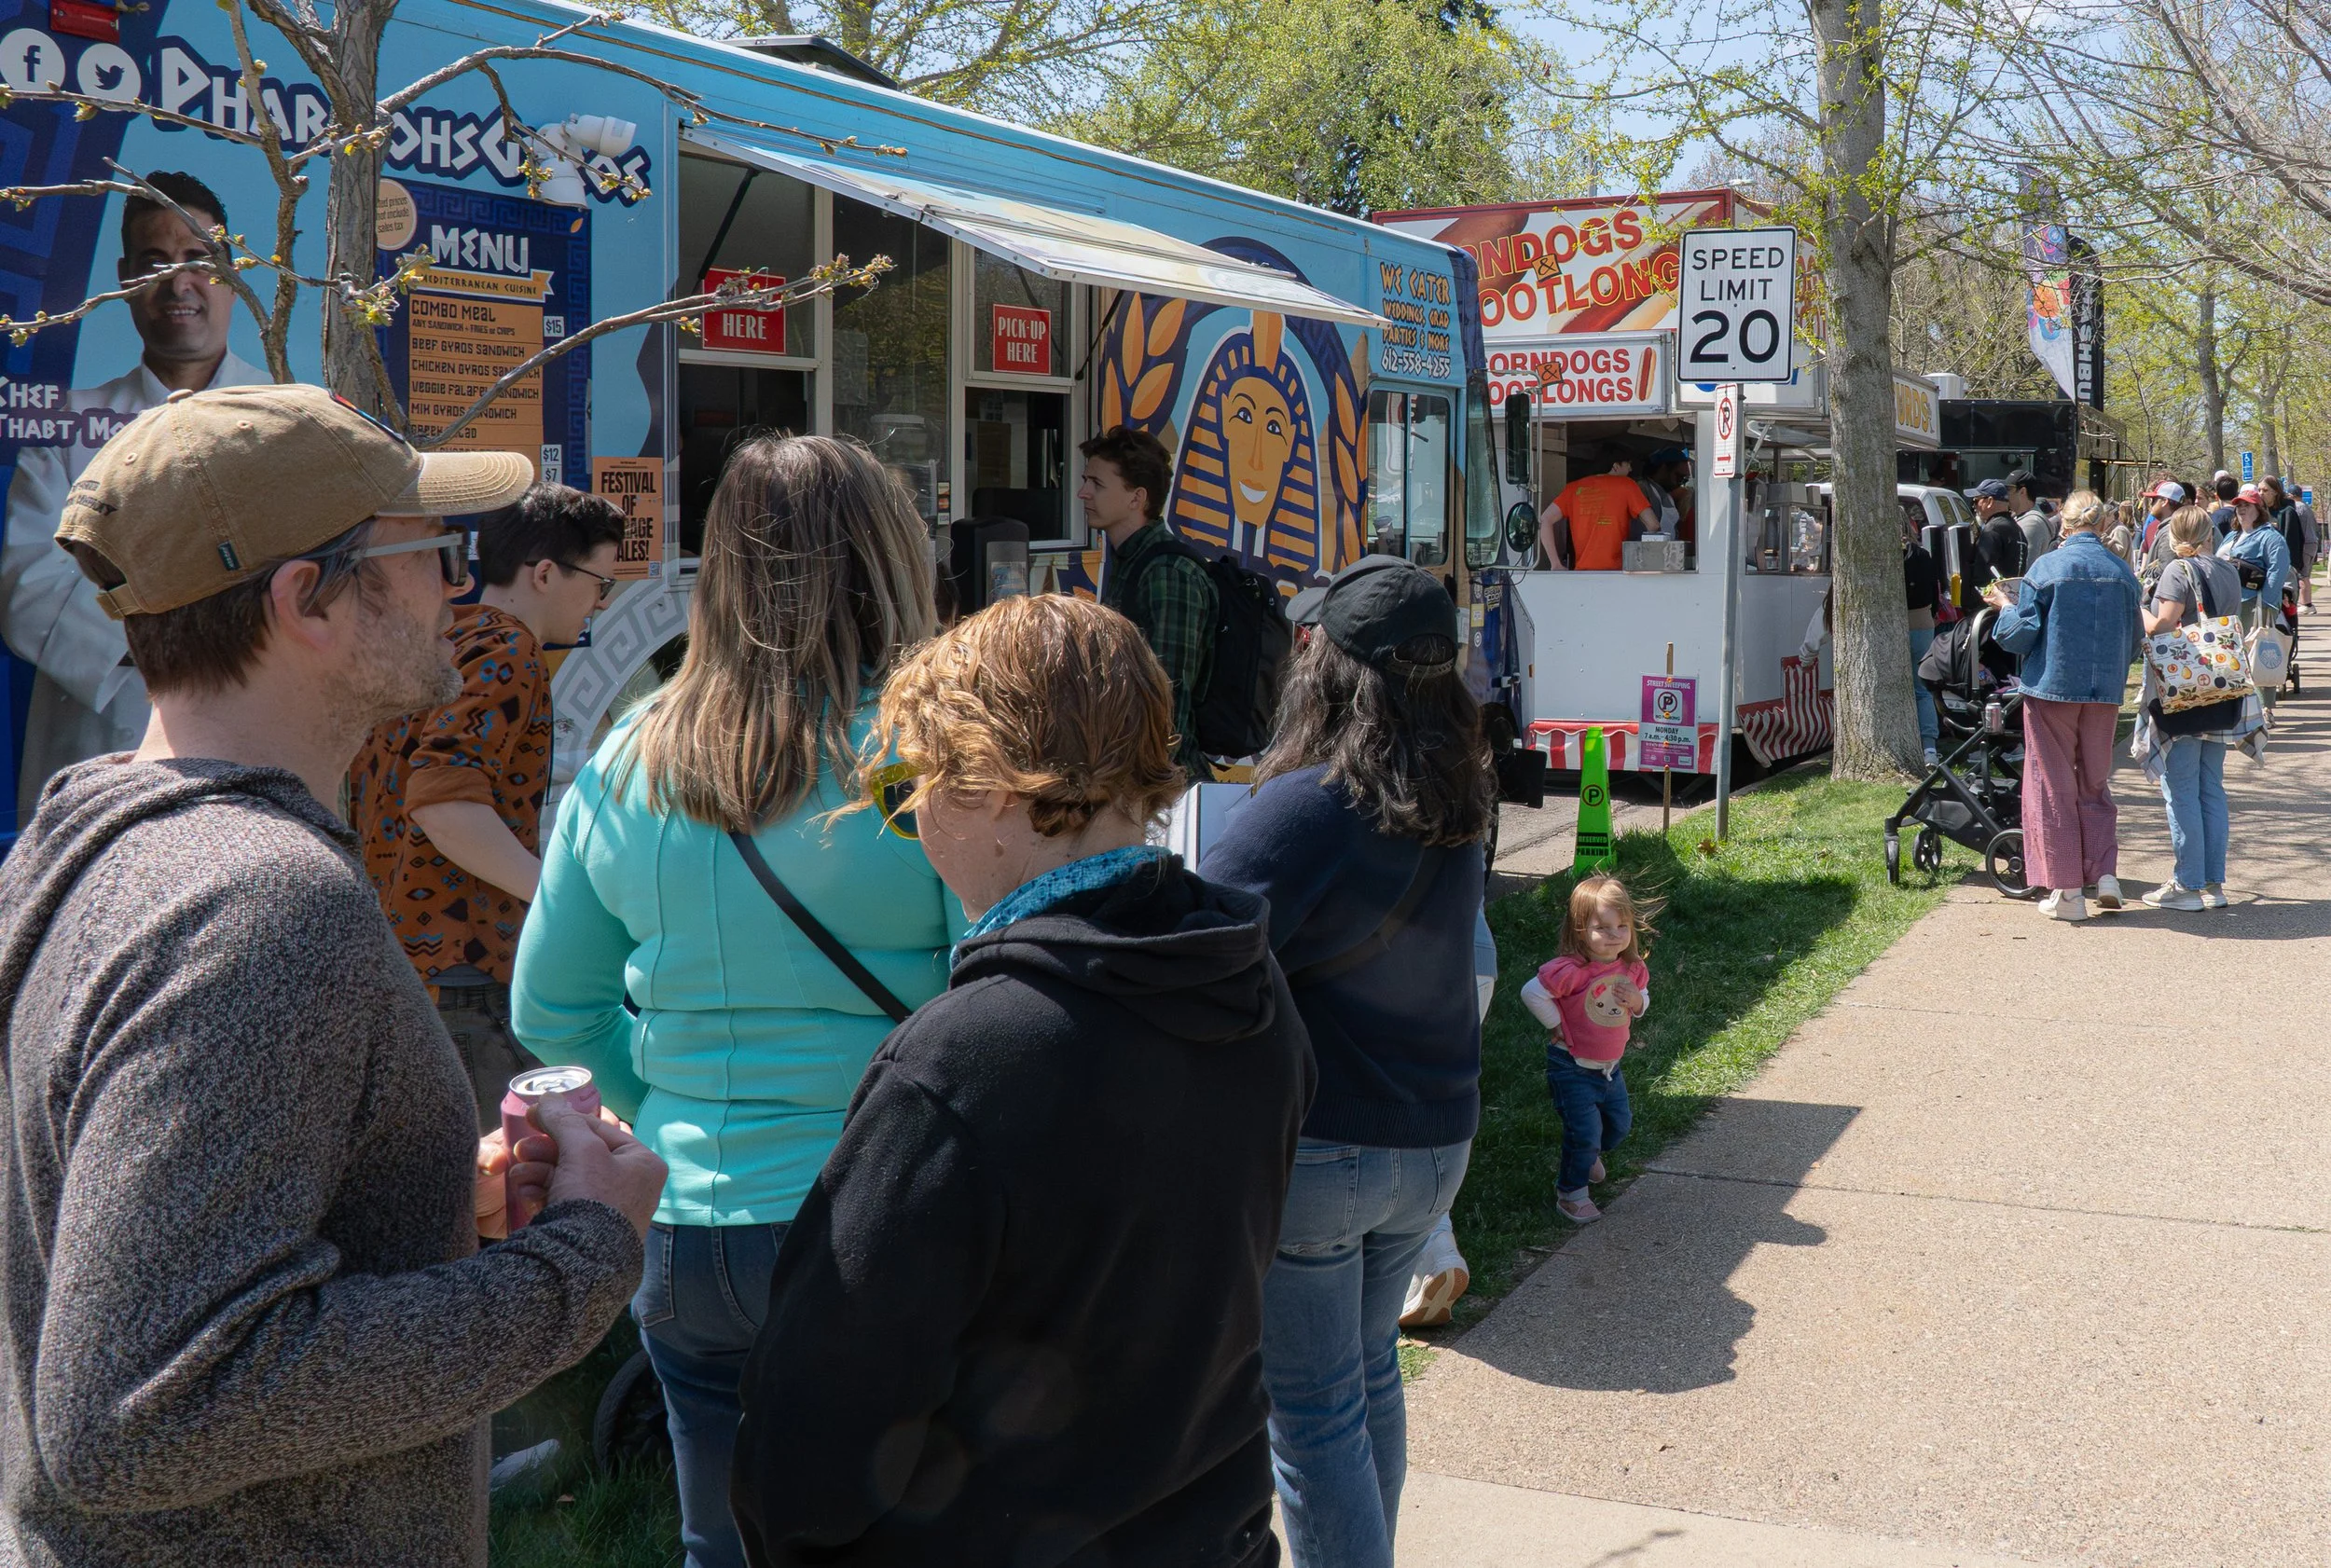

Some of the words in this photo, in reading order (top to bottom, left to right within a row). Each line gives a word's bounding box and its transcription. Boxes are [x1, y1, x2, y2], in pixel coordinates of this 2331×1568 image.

[431, 225, 529, 272] MENU
[1691, 247, 1784, 271] SPEED
[421, 273, 499, 292] MEDITERRANEAN
[504, 283, 537, 296] CUISINE
[1380, 262, 1402, 296] WE
[1409, 268, 1451, 306] CATER
[1479, 252, 1680, 327] OOTLONG
[1700, 279, 1773, 301] LIMIT
[412, 299, 457, 319] COMBO
[1383, 297, 1426, 327] WEDDINGS,
[1428, 308, 1450, 329] GRAD
[412, 319, 426, 328] ANY
[428, 320, 463, 332] SANDWICH
[545, 319, 561, 335] $15
[723, 313, 767, 340] HERE
[998, 316, 1046, 340] PICK-UP
[1690, 309, 1780, 364] 20
[441, 340, 473, 354] GYROS
[1383, 325, 1416, 349] PARTIES
[1428, 331, 1450, 353] MORE
[1007, 342, 1038, 364] HERE
[1381, 346, 1451, 379] 612-558-4255
[1489, 348, 1631, 378] ORNDOGS
[459, 364, 489, 377] GYROS
[1487, 378, 1634, 406] OOTLONGS
[434, 404, 465, 419] GYROS
[1894, 381, 1929, 433] URDS
[543, 447, 559, 461] $12
[545, 468, 557, 482] $7
[601, 471, 656, 494] FESTIVAL
[622, 494, 637, 516] OF
[615, 540, 650, 562] ALES!
[1664, 681, 1691, 690] SWEEPING
[1655, 726, 1679, 735] MONDAY
[1577, 847, 1608, 857] PARKING
